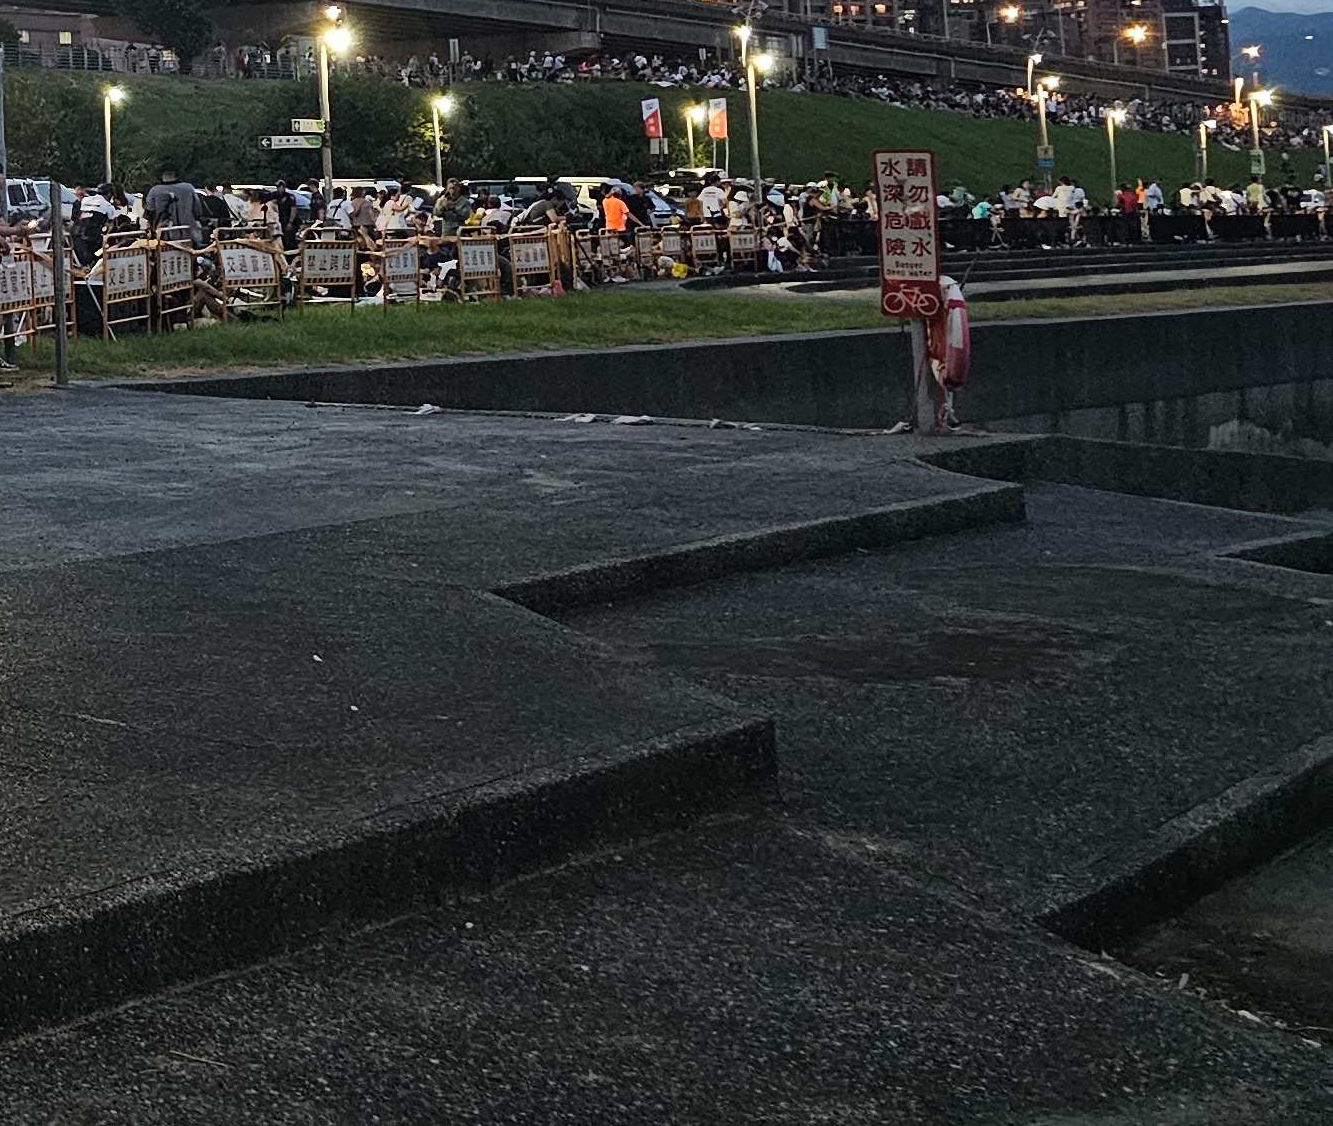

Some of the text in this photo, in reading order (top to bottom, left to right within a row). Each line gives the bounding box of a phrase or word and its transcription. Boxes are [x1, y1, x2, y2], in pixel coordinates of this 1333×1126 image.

[880, 158, 906, 257] 水深危險
[906, 158, 931, 257] 請勿戲水
